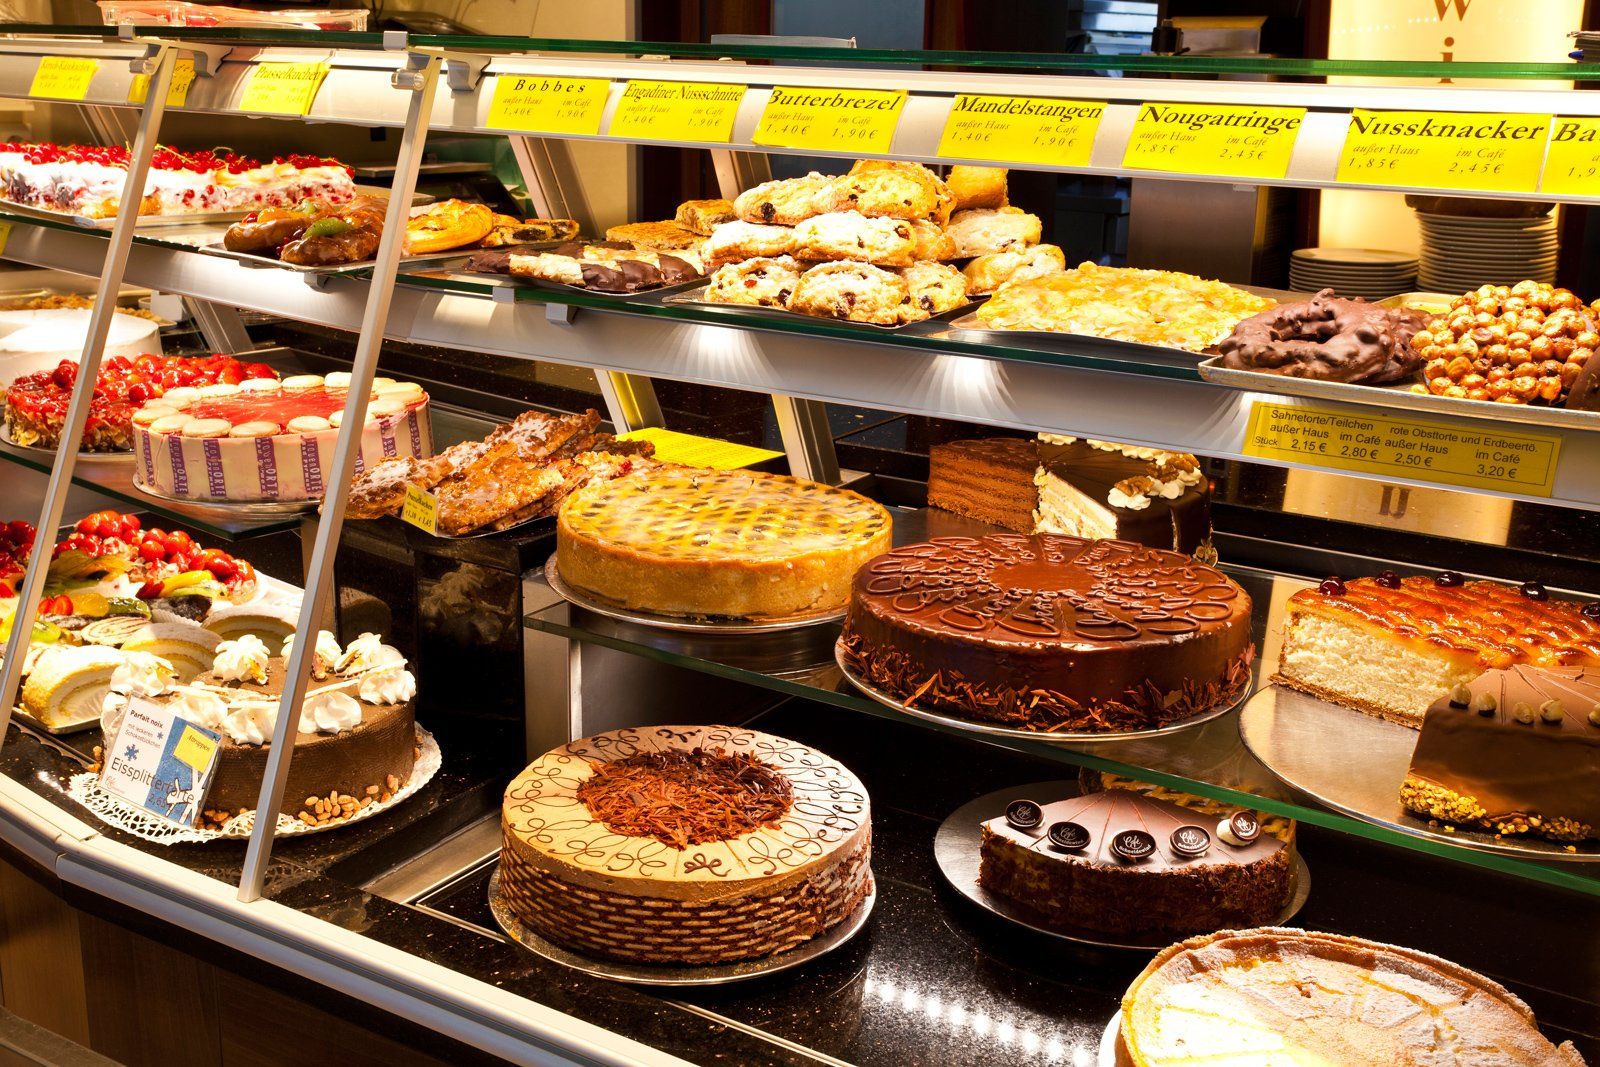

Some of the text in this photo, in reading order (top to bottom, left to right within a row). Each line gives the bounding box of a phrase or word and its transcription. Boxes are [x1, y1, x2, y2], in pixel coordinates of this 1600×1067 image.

[514, 79, 586, 93] Bobbes
[623, 83, 677, 102] Engadiner
[768, 89, 902, 111] Butterbrezel
[768, 112, 815, 122] außer Haus
[953, 96, 1103, 123] Mandelstangen
[955, 120, 1010, 131] außer Haus
[1138, 105, 1301, 135] Nougatringe
[1055, 123, 1079, 135] Café
[1348, 115, 1545, 141] Nussknacker
[1139, 130, 1197, 142] außer Haus
[1226, 134, 1269, 147] im Café
[1352, 142, 1421, 156] außer Haus
[1455, 147, 1506, 159] im Café
[1270, 409, 1374, 431] Sahnetorte/Teilchen
[1269, 423, 1329, 439] außer Haus
[1339, 431, 1381, 446] im Café
[1254, 435, 1278, 446] Stück
[1291, 438, 1328, 453] 2,15 €
[1384, 438, 1449, 455] außer Haus
[1389, 427, 1538, 453] rote Obsttorte und Erdbeertö.
[1340, 445, 1379, 460] 2,80 €
[1394, 452, 1433, 467] 2,50 €
[1475, 449, 1520, 464] im Café
[1476, 464, 1518, 479] 3,20 €
[130, 709, 164, 729] Parfait noix
